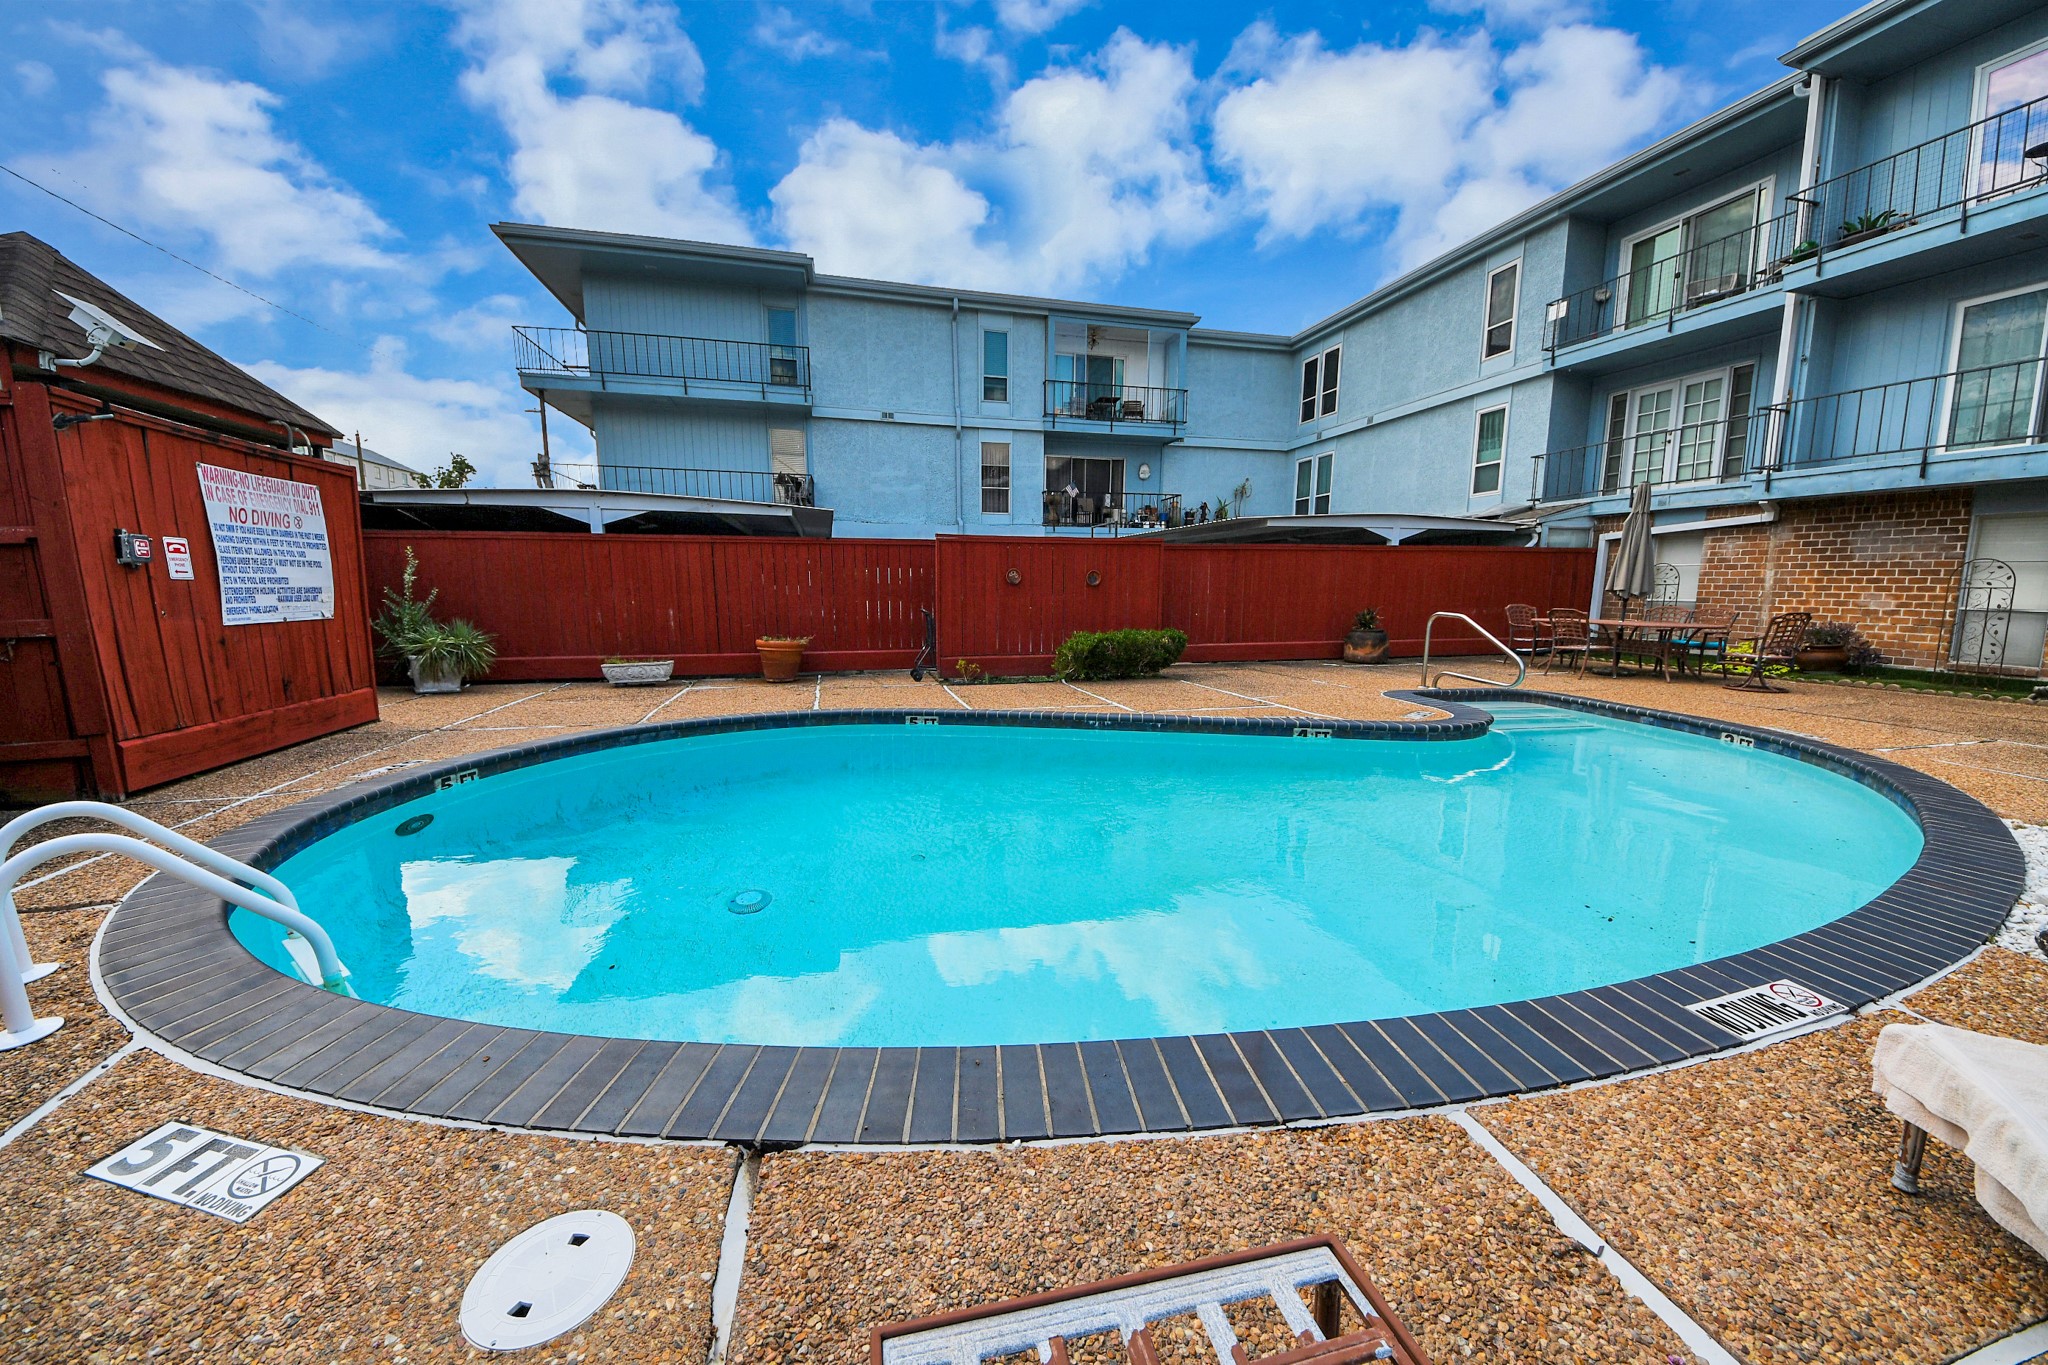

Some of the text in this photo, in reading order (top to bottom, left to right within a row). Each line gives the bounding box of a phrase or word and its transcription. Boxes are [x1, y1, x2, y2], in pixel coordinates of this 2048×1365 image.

[250, 475, 290, 496] LIFEGUARD
[291, 483, 300, 498] ON
[302, 484, 317, 501] DUTY
[204, 484, 320, 516] IN CASE OF EMERGENCY DIAL 911
[229, 506, 290, 529] NO DIVING
[218, 545, 231, 554] GLASS
[231, 546, 244, 555] ITEMS
[244, 547, 253, 555] NOT
[253, 547, 272, 556] ALLOWED
[277, 549, 286, 557] THE
[286, 549, 297, 558] POOL
[296, 550, 306, 559] YARD
[222, 565, 277, 575] WITHOUT ADULT SUPERVISION
[223, 576, 233, 585] PETS
[238, 577, 247, 585] THE
[246, 577, 259, 585] POOL
[259, 577, 267, 585] ARE
[266, 577, 289, 585] PROHIBITED
[224, 587, 244, 595] EXTENDED
[244, 587, 259, 595] BREATH
[260, 587, 276, 595] HOLDING
[277, 587, 295, 595] ACTIVITIES
[303, 587, 322, 595] DANGEROUS
[225, 596, 256, 604] AND PROHIBITED
[226, 606, 248, 616] EMERGENCY
[249, 605, 262, 614] PHONE
[262, 605, 279, 614] LOCATION
[441, 771, 476, 790] 5 FT
[1695, 992, 1809, 1036] NO DIVING
[107, 1128, 259, 1197] 5 FT.
[193, 1192, 253, 1218] NO DIVING
